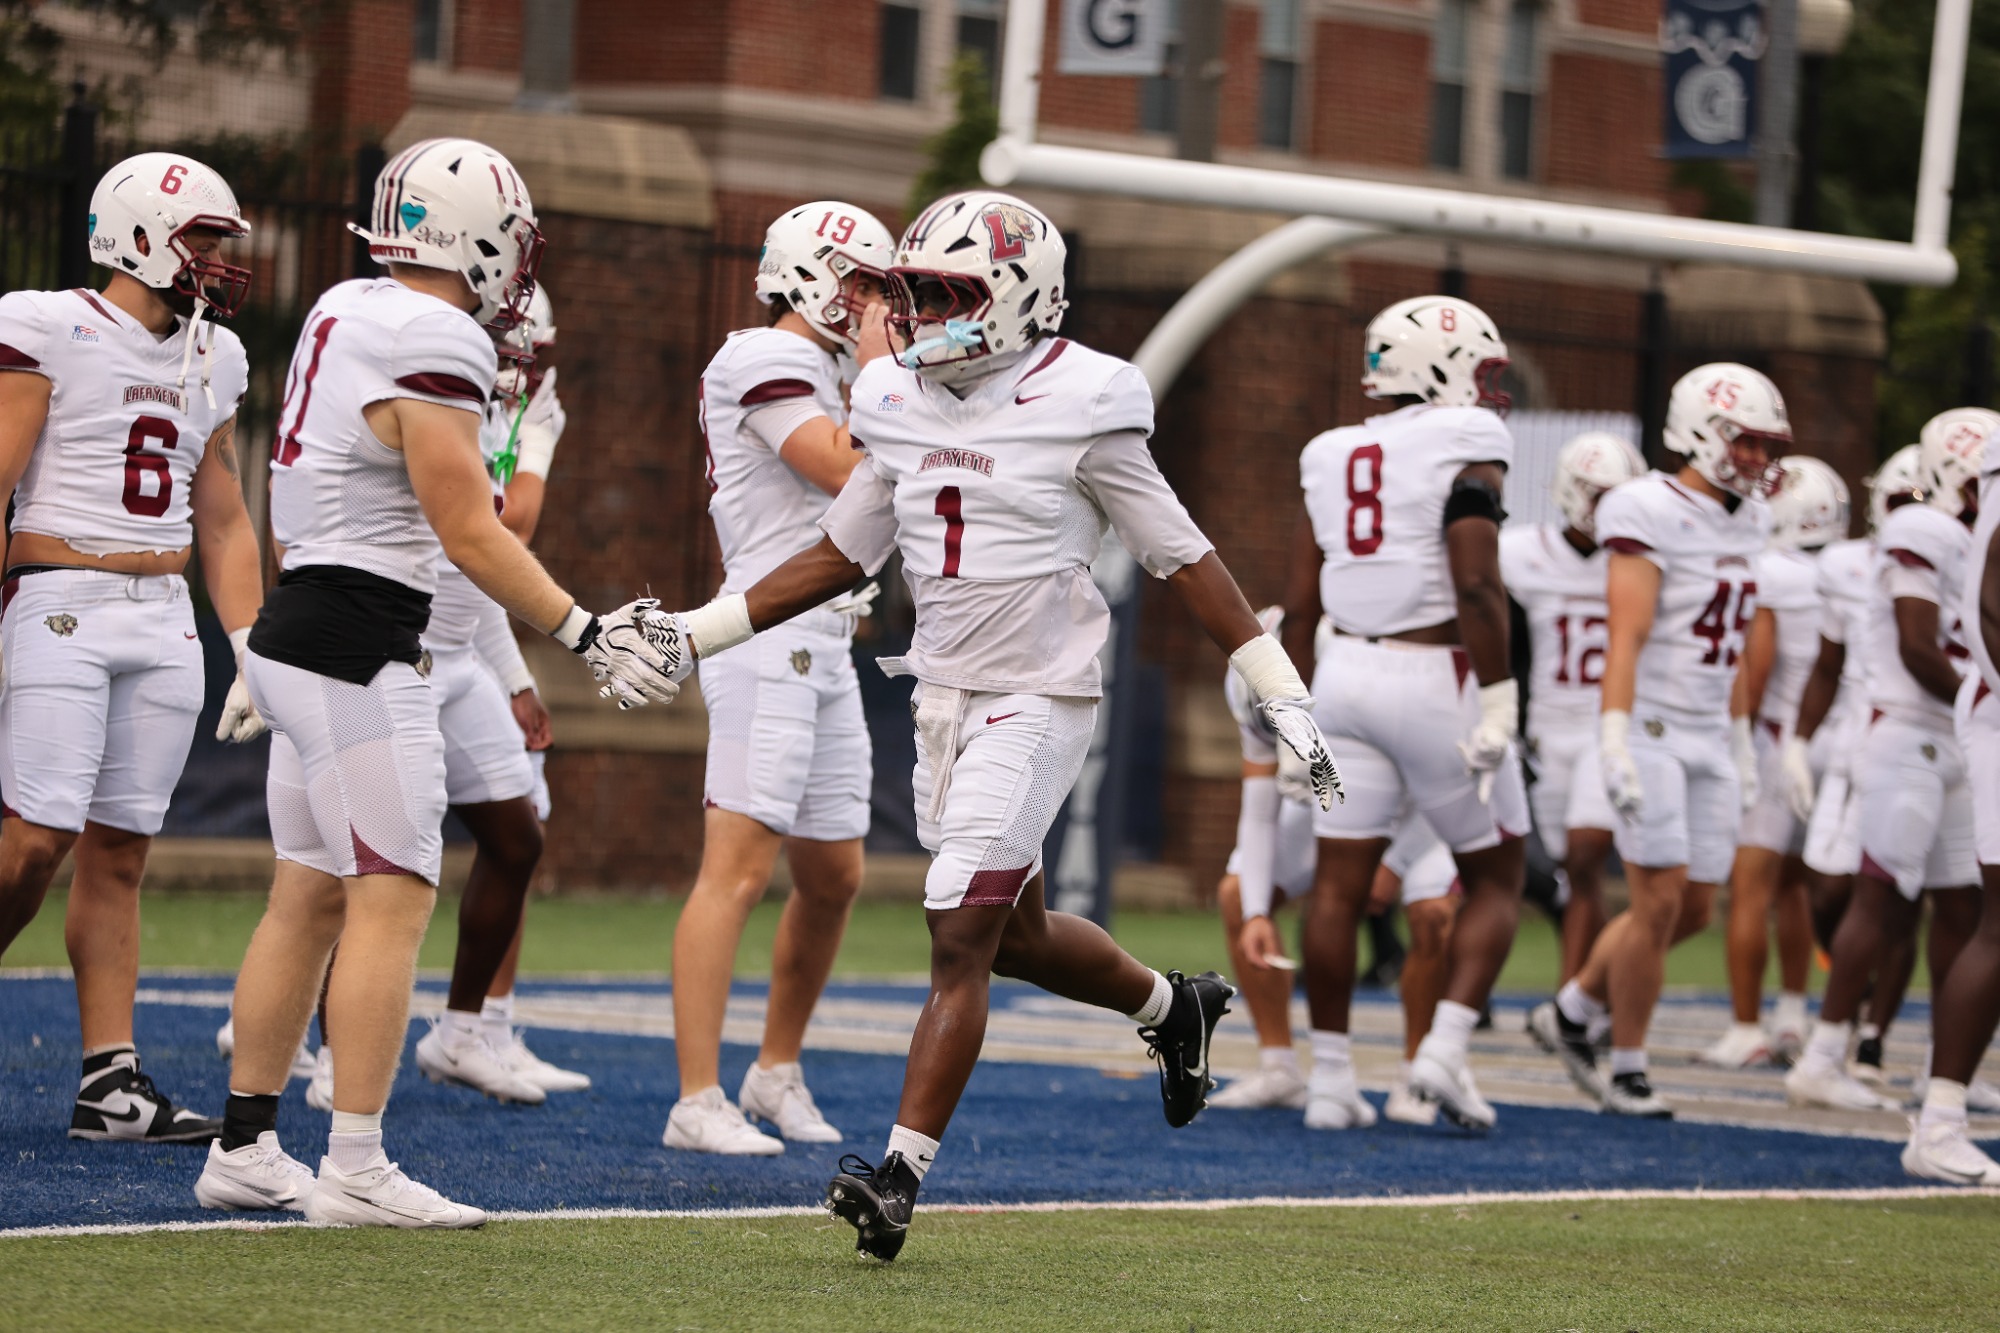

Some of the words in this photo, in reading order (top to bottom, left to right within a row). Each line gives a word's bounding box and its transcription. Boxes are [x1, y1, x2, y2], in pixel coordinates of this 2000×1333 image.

[1087, 0, 1136, 50] G
[160, 164, 189, 195] 6
[815, 210, 857, 245] 19
[982, 209, 1026, 264] L
[1441, 308, 1456, 332] 8
[123, 385, 181, 410] LAFAYETT
[272, 310, 340, 467] 11
[122, 415, 179, 518] 6
[918, 449, 993, 476] LAFAYETTE
[1346, 443, 1383, 556] 8
[935, 486, 965, 578] 1
